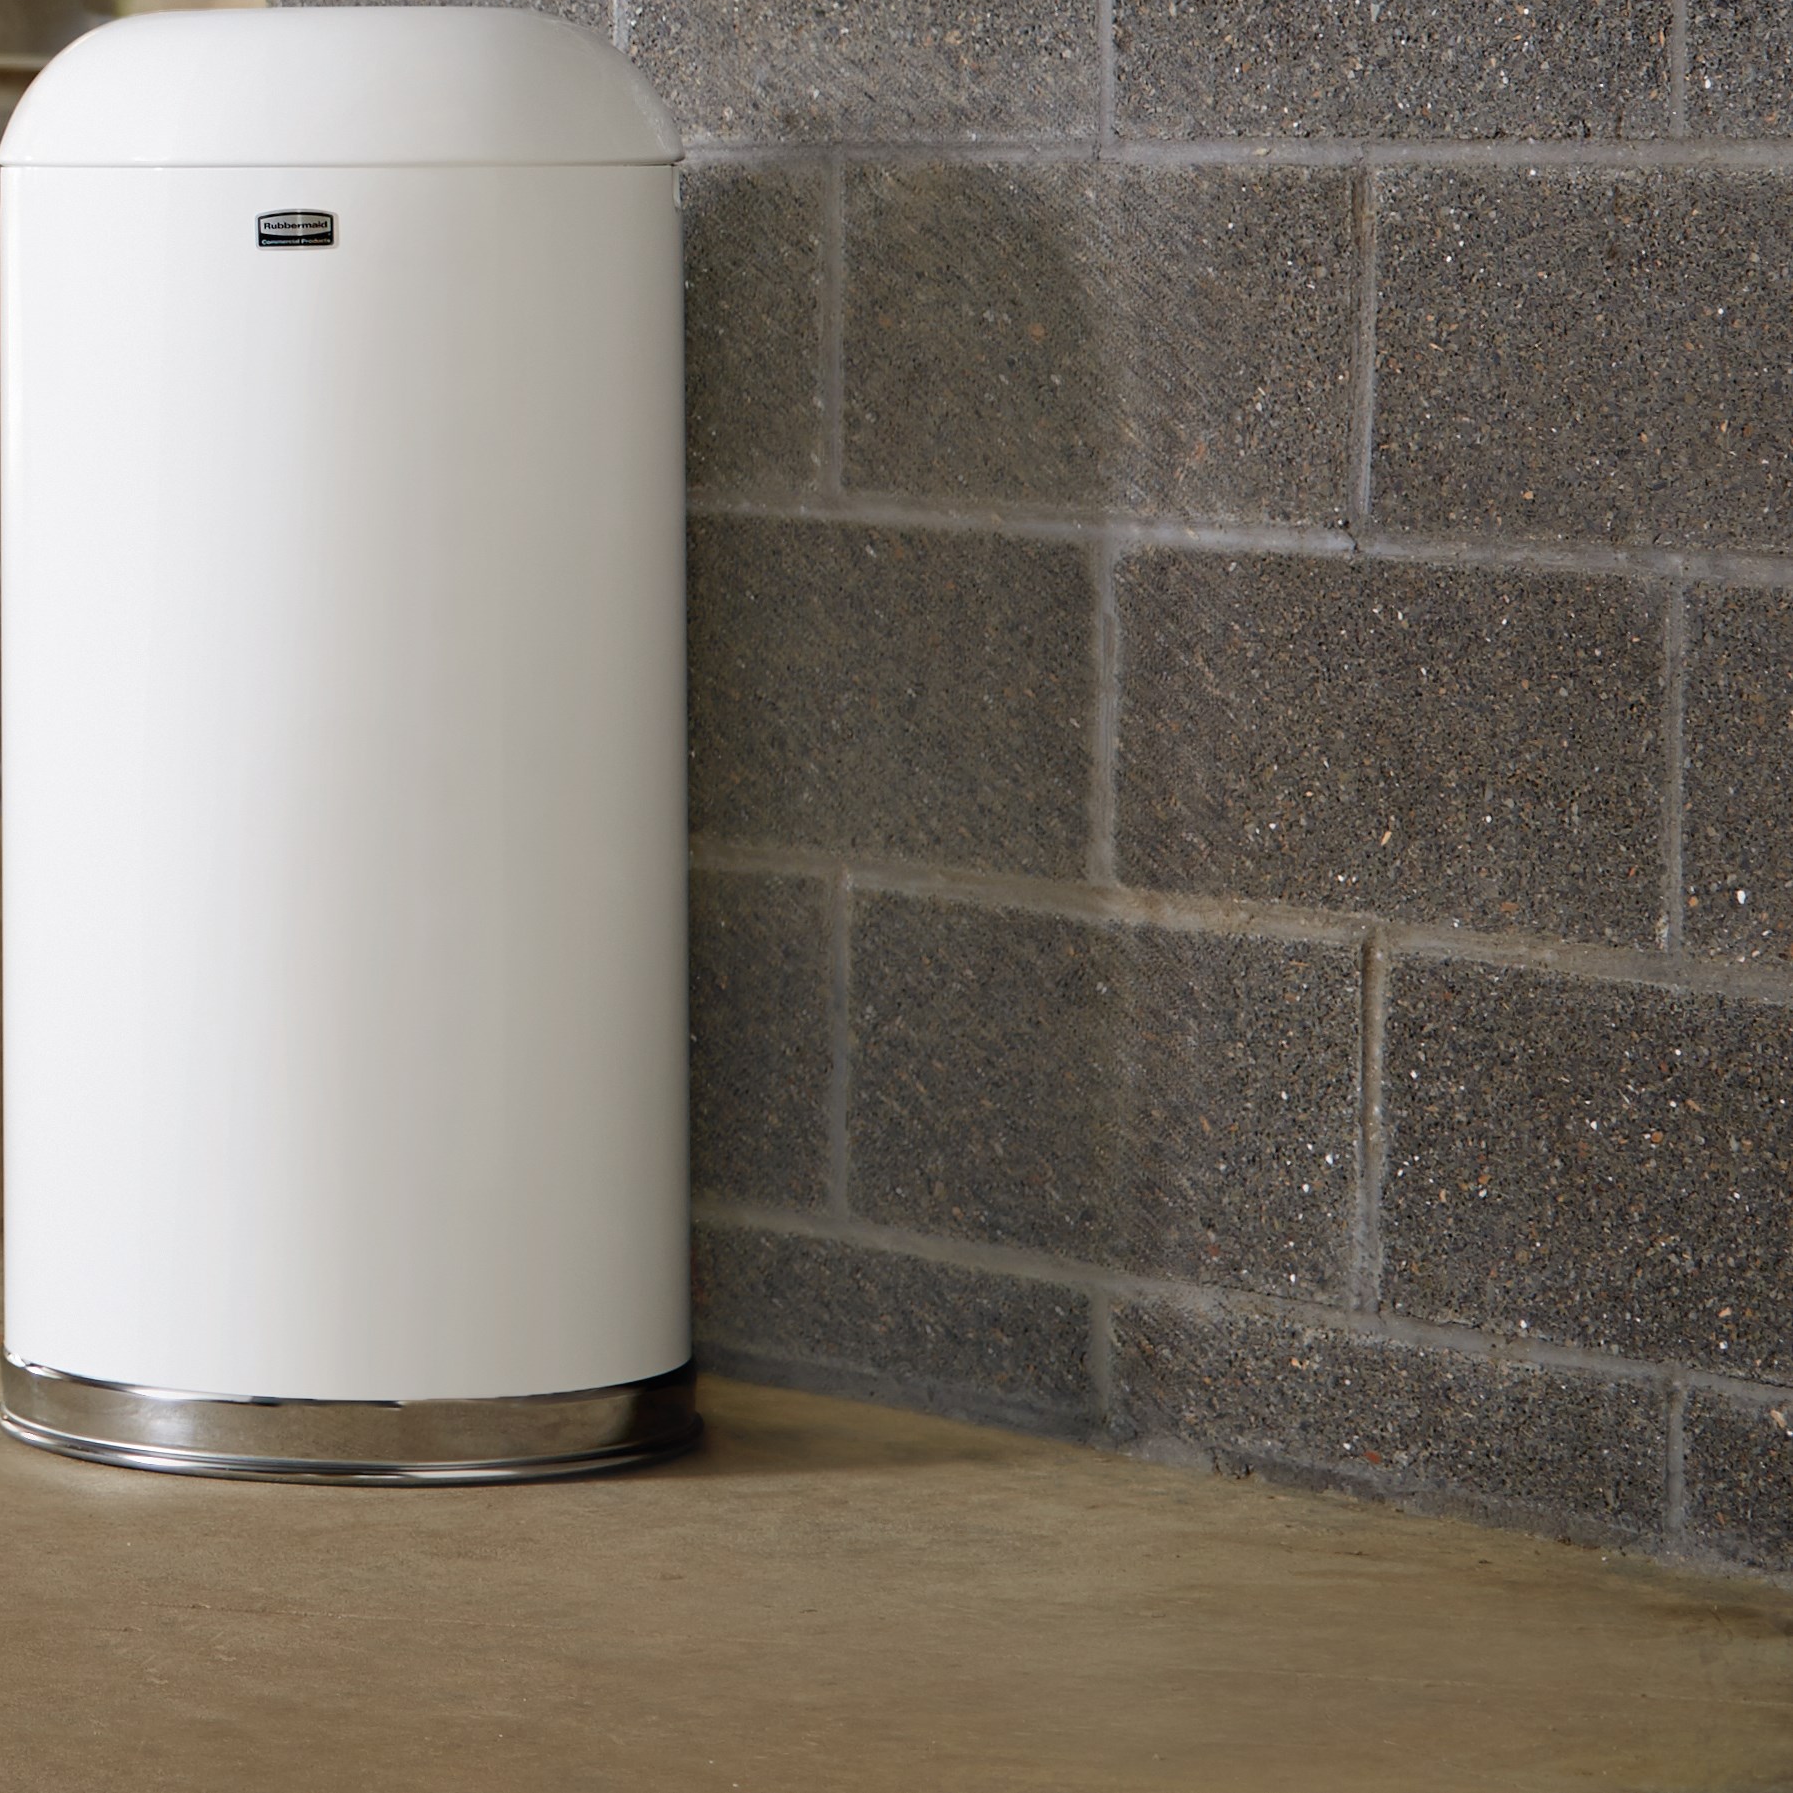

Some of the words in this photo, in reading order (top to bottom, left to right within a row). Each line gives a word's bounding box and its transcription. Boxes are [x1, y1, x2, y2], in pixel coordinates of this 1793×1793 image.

[263, 220, 328, 230] Rubbermaid
[261, 238, 300, 246] Commercial
[300, 237, 331, 246] Products
